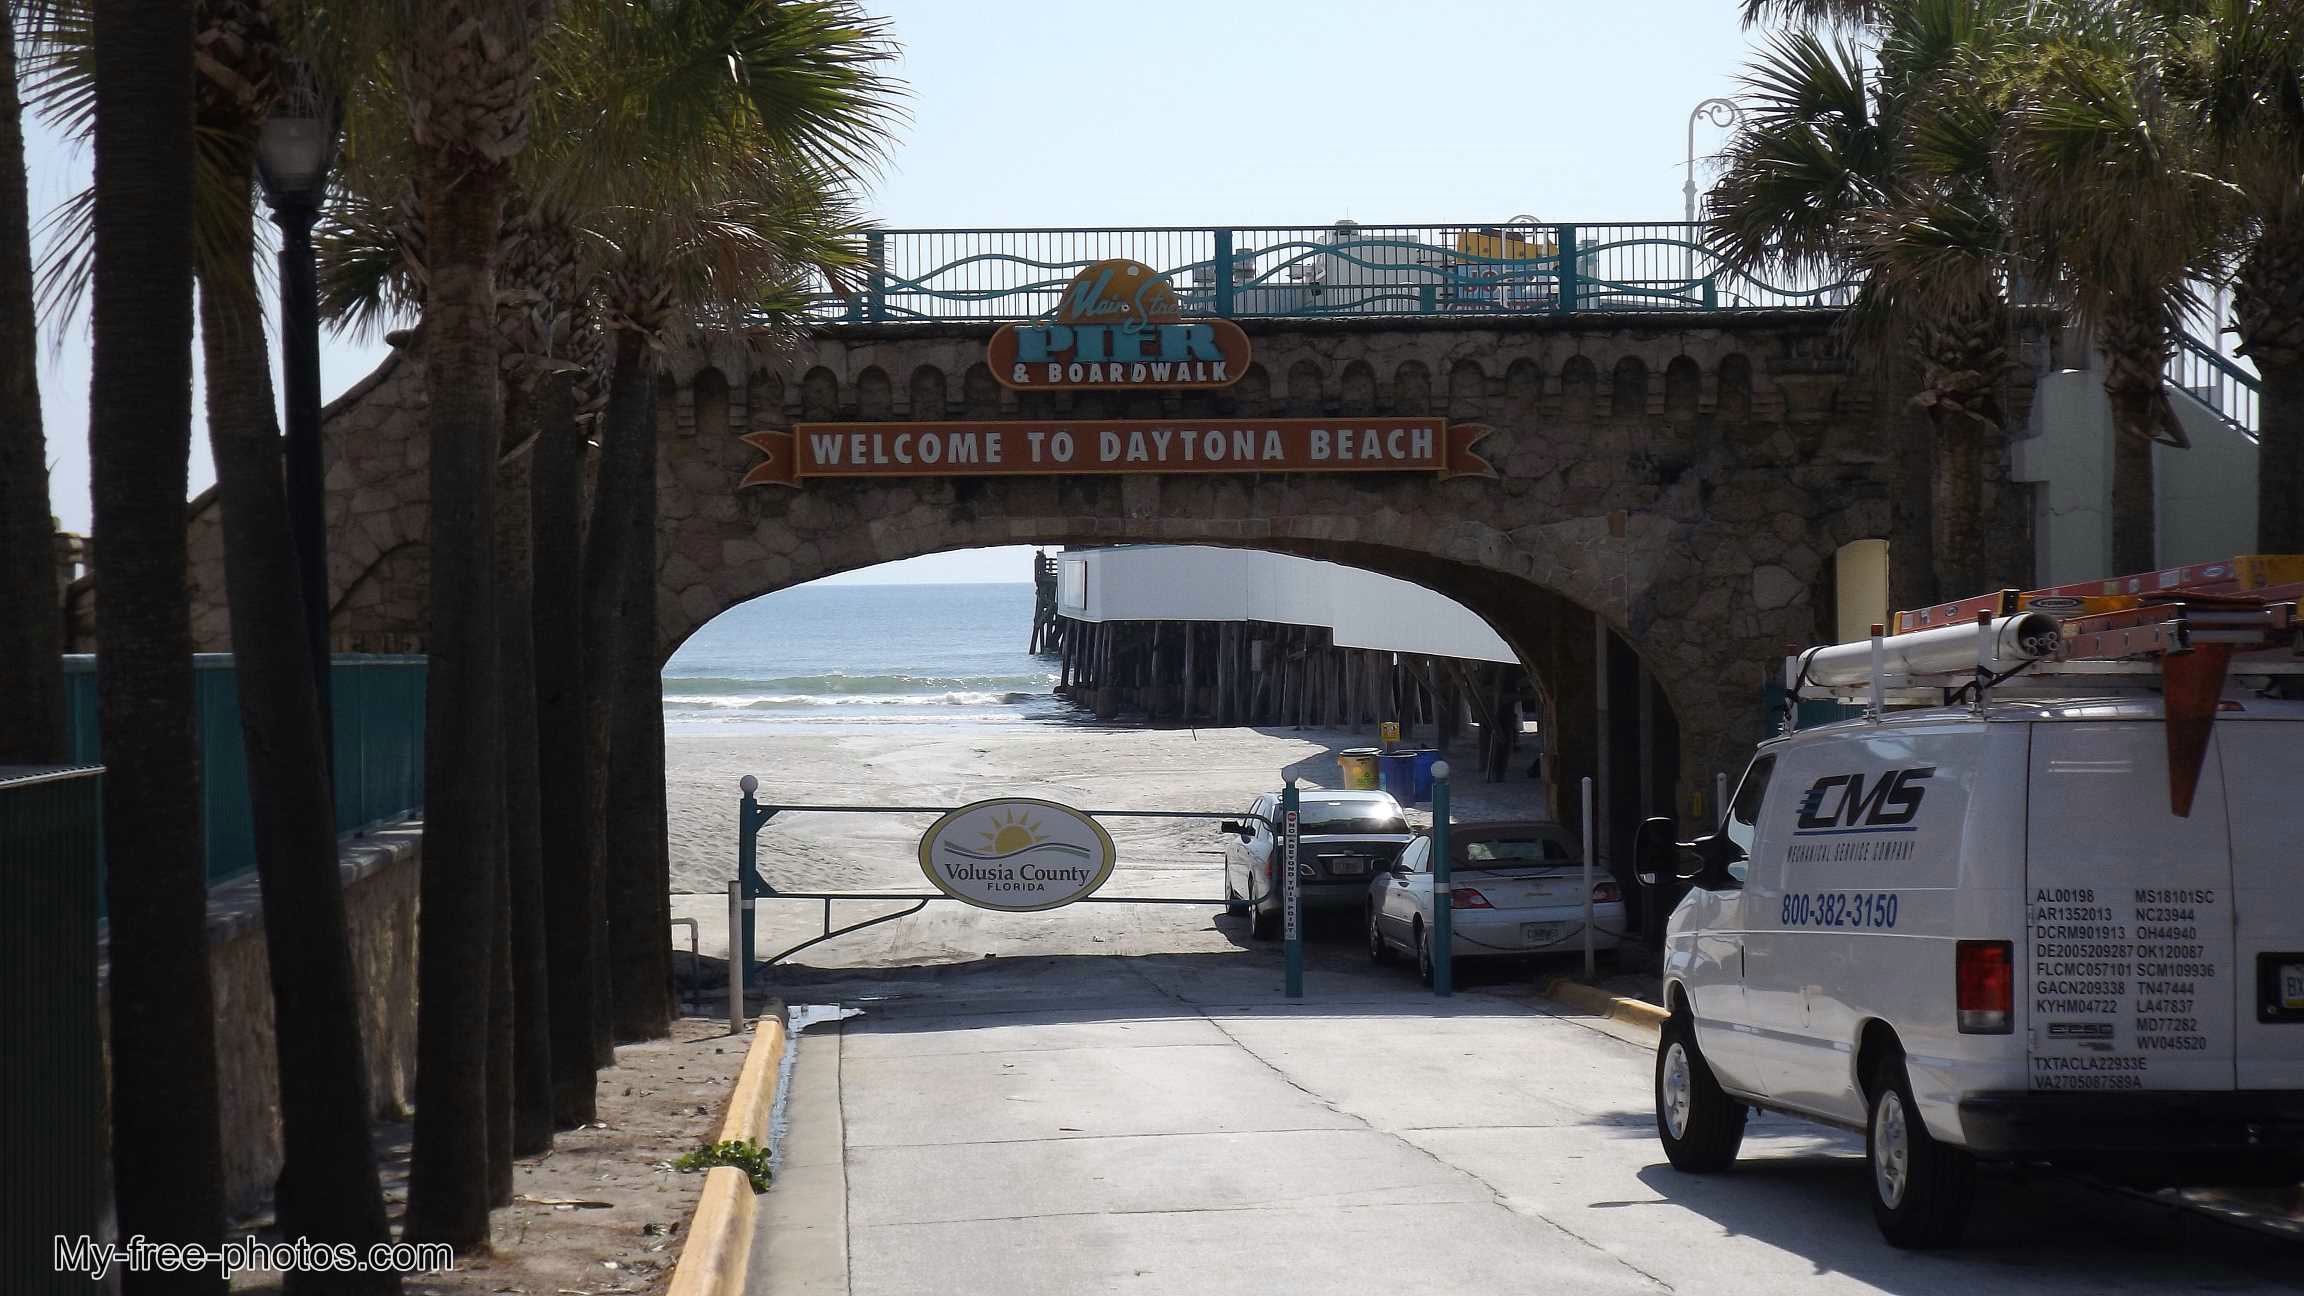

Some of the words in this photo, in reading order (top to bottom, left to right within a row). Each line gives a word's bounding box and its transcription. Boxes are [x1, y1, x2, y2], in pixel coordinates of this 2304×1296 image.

[1014, 323, 1228, 363] PIER
[1012, 363, 1030, 384] &
[1049, 361, 1229, 384] BOARDWALK
[810, 431, 1001, 465] WELCOME
[1026, 430, 1075, 463] TO
[1099, 429, 1286, 462] DAYTONA
[1310, 428, 1434, 460] BEACH
[1796, 766, 1937, 829] CMS
[1787, 844, 1831, 864] MECHANICAL
[1833, 842, 1871, 863] SERVICE
[1872, 840, 1916, 862] COMPANY
[945, 863, 1014, 881] Volusia
[1020, 863, 1091, 887] County
[987, 882, 1046, 892] FLORIDA
[2037, 889, 2095, 903] AL00198
[2135, 890, 2216, 904] MS18101SC
[1782, 893, 1899, 928] 800-382-3150
[2037, 907, 2113, 922] AR1352013
[2136, 908, 2195, 922] NC23944
[2037, 926, 2126, 940] DCRM901913
[2136, 926, 2197, 941] OH44940
[2037, 944, 2134, 959] DE2005209287
[2037, 962, 2132, 977] FLCMC057101
[2136, 963, 2216, 978] SCM109936
[2037, 981, 2126, 995] GACN209338
[2137, 982, 2195, 995] TN47444
[2037, 999, 2119, 1014] KYHM04722
[2136, 1000, 2195, 1014] LA47837
[2136, 1017, 2198, 1032] MD77282
[2136, 1036, 2208, 1051] WV045520
[2034, 1056, 2148, 1071] TXTACLA22933E
